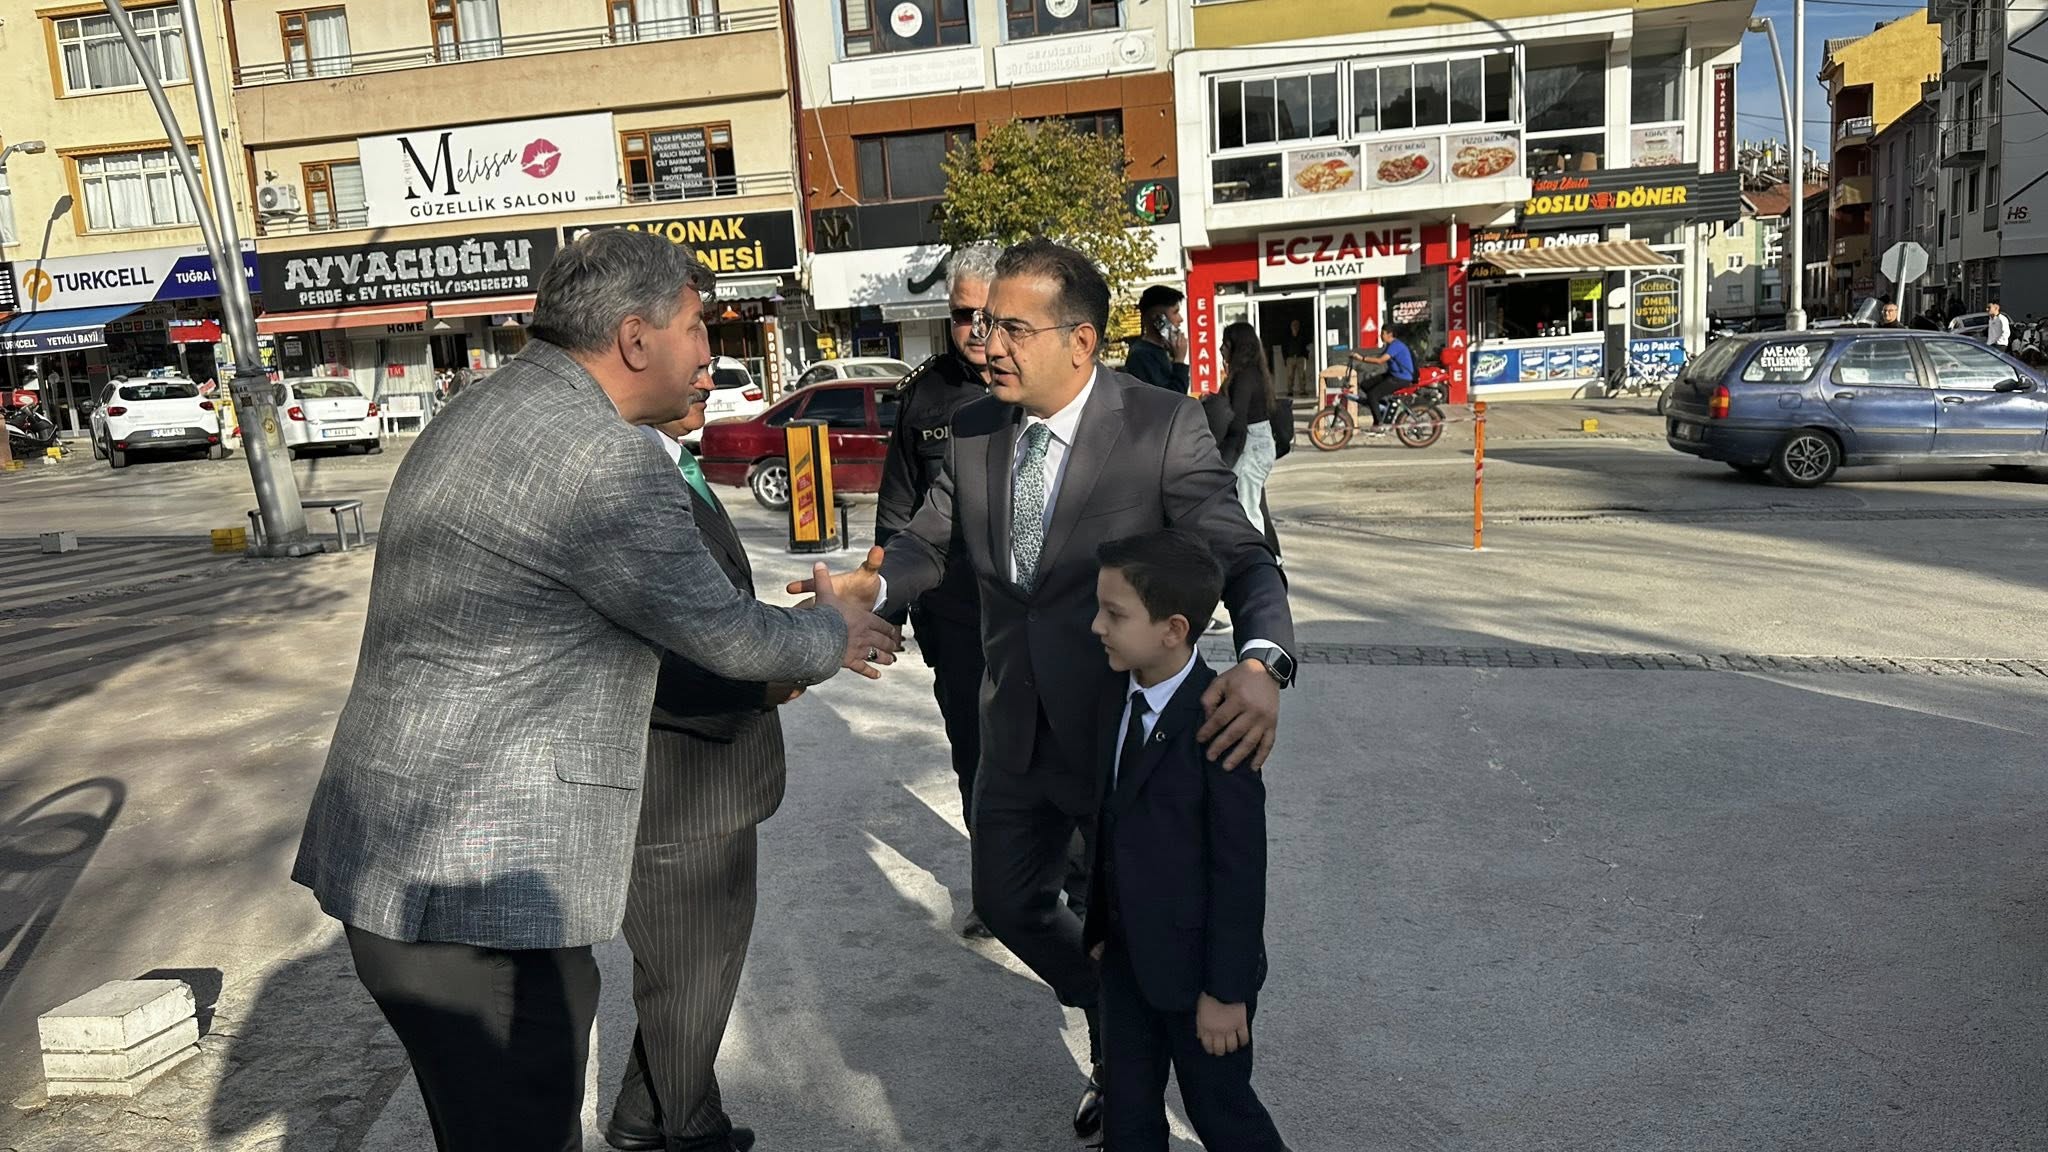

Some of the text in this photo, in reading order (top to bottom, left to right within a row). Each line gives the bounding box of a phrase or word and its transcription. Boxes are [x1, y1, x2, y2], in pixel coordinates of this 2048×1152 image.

[397, 132, 517, 200] Melissa
[410, 190, 576, 217] GÜZELLİK SALONU
[1523, 186, 1687, 215] SOSLU DÖNER
[2008, 206, 2028, 219] HS
[648, 217, 746, 244] KONAK
[696, 240, 763, 271] NESİ
[1266, 228, 1413, 267] ECZANE
[176, 269, 211, 284] TUĞRA
[284, 237, 533, 290] AYVACIOĞLU
[1314, 262, 1364, 277] HAYAT
[53, 267, 154, 293] TURKCELL
[299, 289, 342, 305] PERDE
[359, 285, 378, 300] EV
[47, 333, 77, 346] YETKİLİ
[387, 322, 424, 334] HOME
[1197, 298, 1209, 391] ECZANE
[1632, 342, 1649, 352] Alo
[1763, 344, 1808, 357] MEMO
